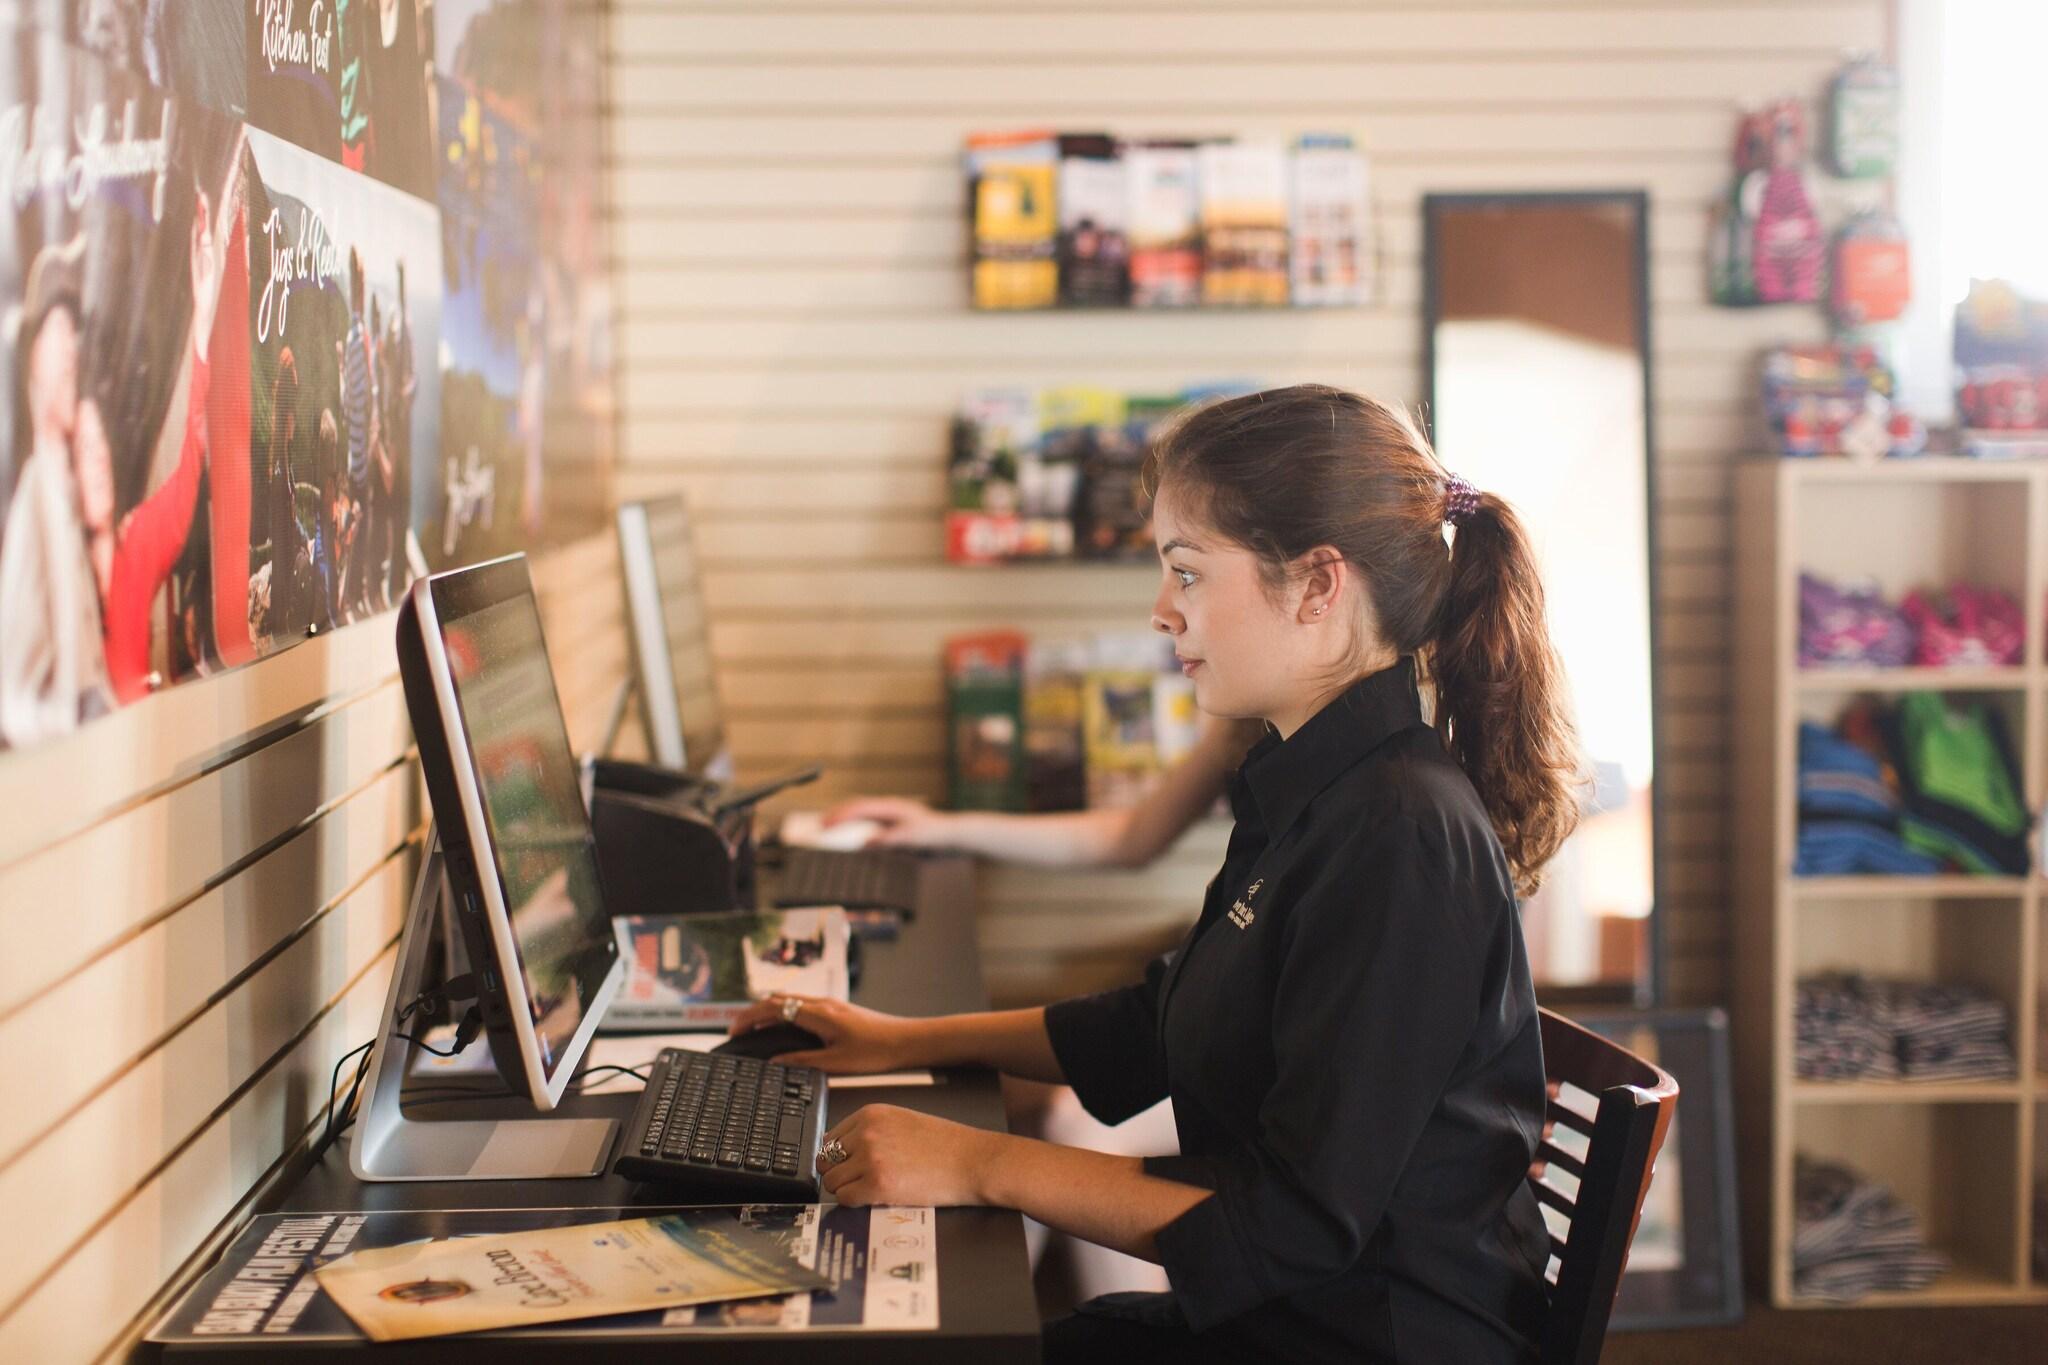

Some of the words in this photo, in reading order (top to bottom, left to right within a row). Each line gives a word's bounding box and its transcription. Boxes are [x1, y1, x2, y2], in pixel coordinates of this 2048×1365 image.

[256, 0, 309, 72] Kitchen
[310, 0, 332, 74] Fest
[258, 207, 293, 343] Jigs
[296, 208, 308, 279] &
[254, 1216, 337, 1258] FESTIVAL
[235, 1257, 305, 1281] FILM
[486, 1249, 538, 1285] Breton
